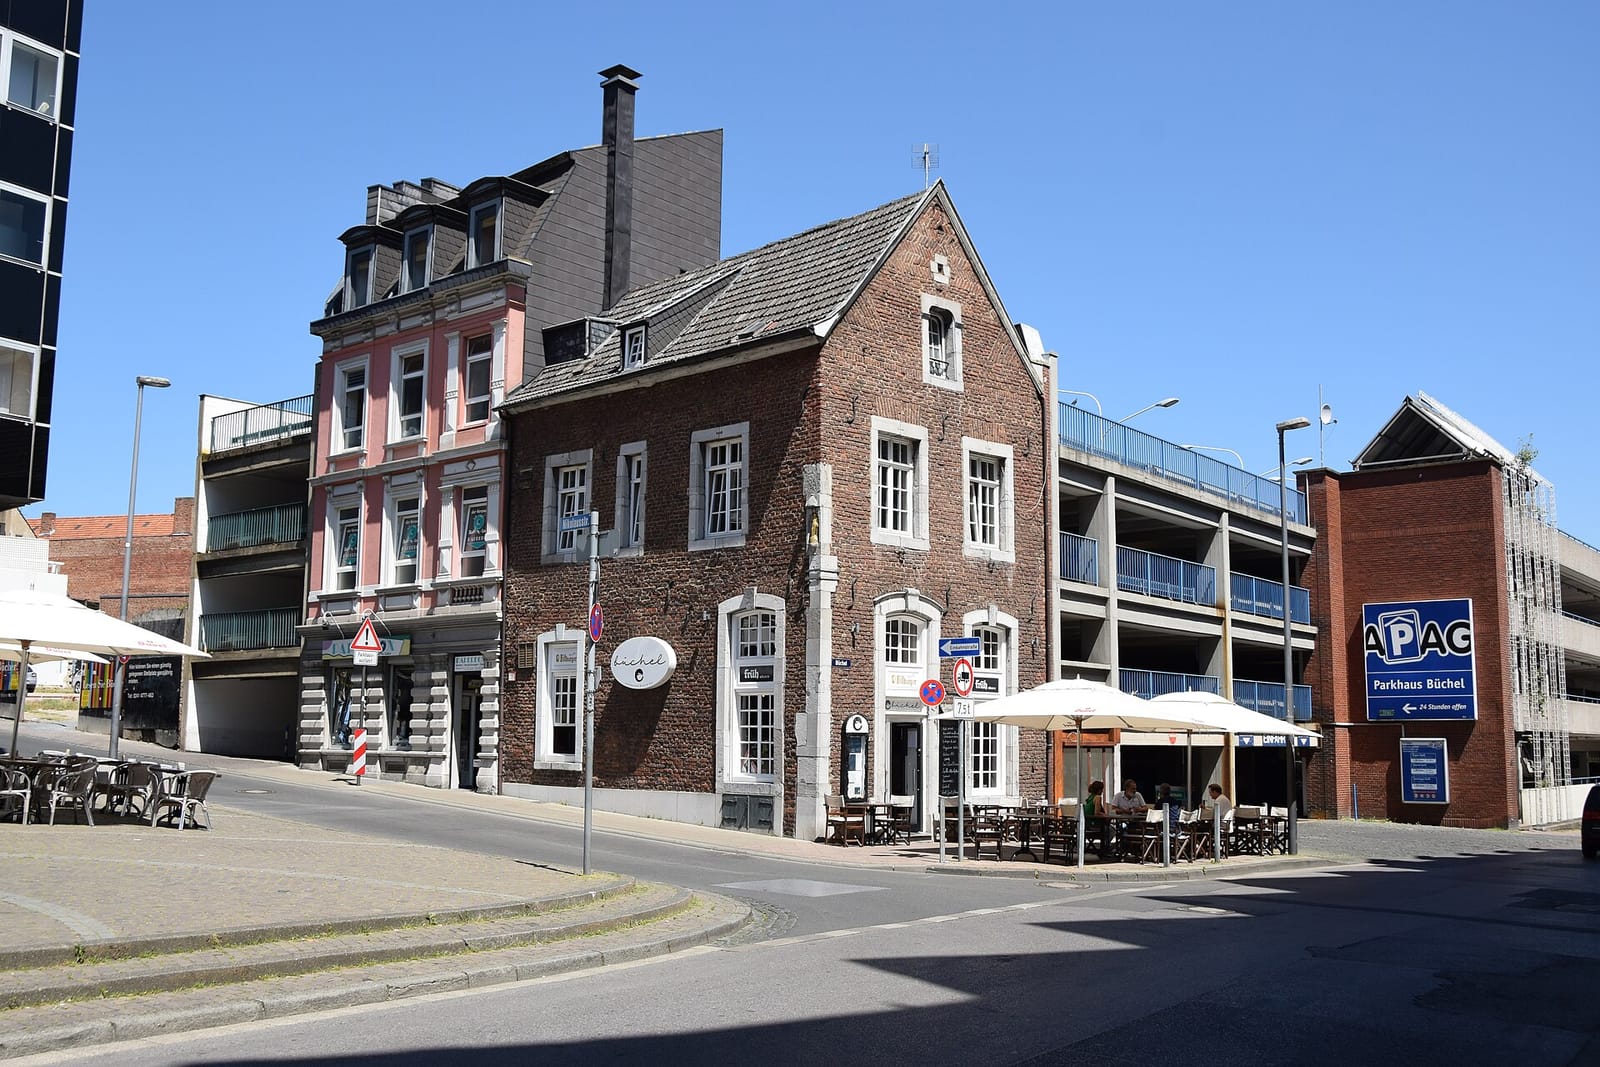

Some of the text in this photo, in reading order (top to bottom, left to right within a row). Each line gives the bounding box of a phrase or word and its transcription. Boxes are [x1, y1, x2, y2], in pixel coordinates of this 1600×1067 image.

[1365, 619, 1471, 659] APAG
[613, 653, 667, 667] büchel
[744, 669, 759, 679] früh
[1374, 678, 1465, 690] Parkhaus Büchel
[1451, 703, 1467, 711] offen
